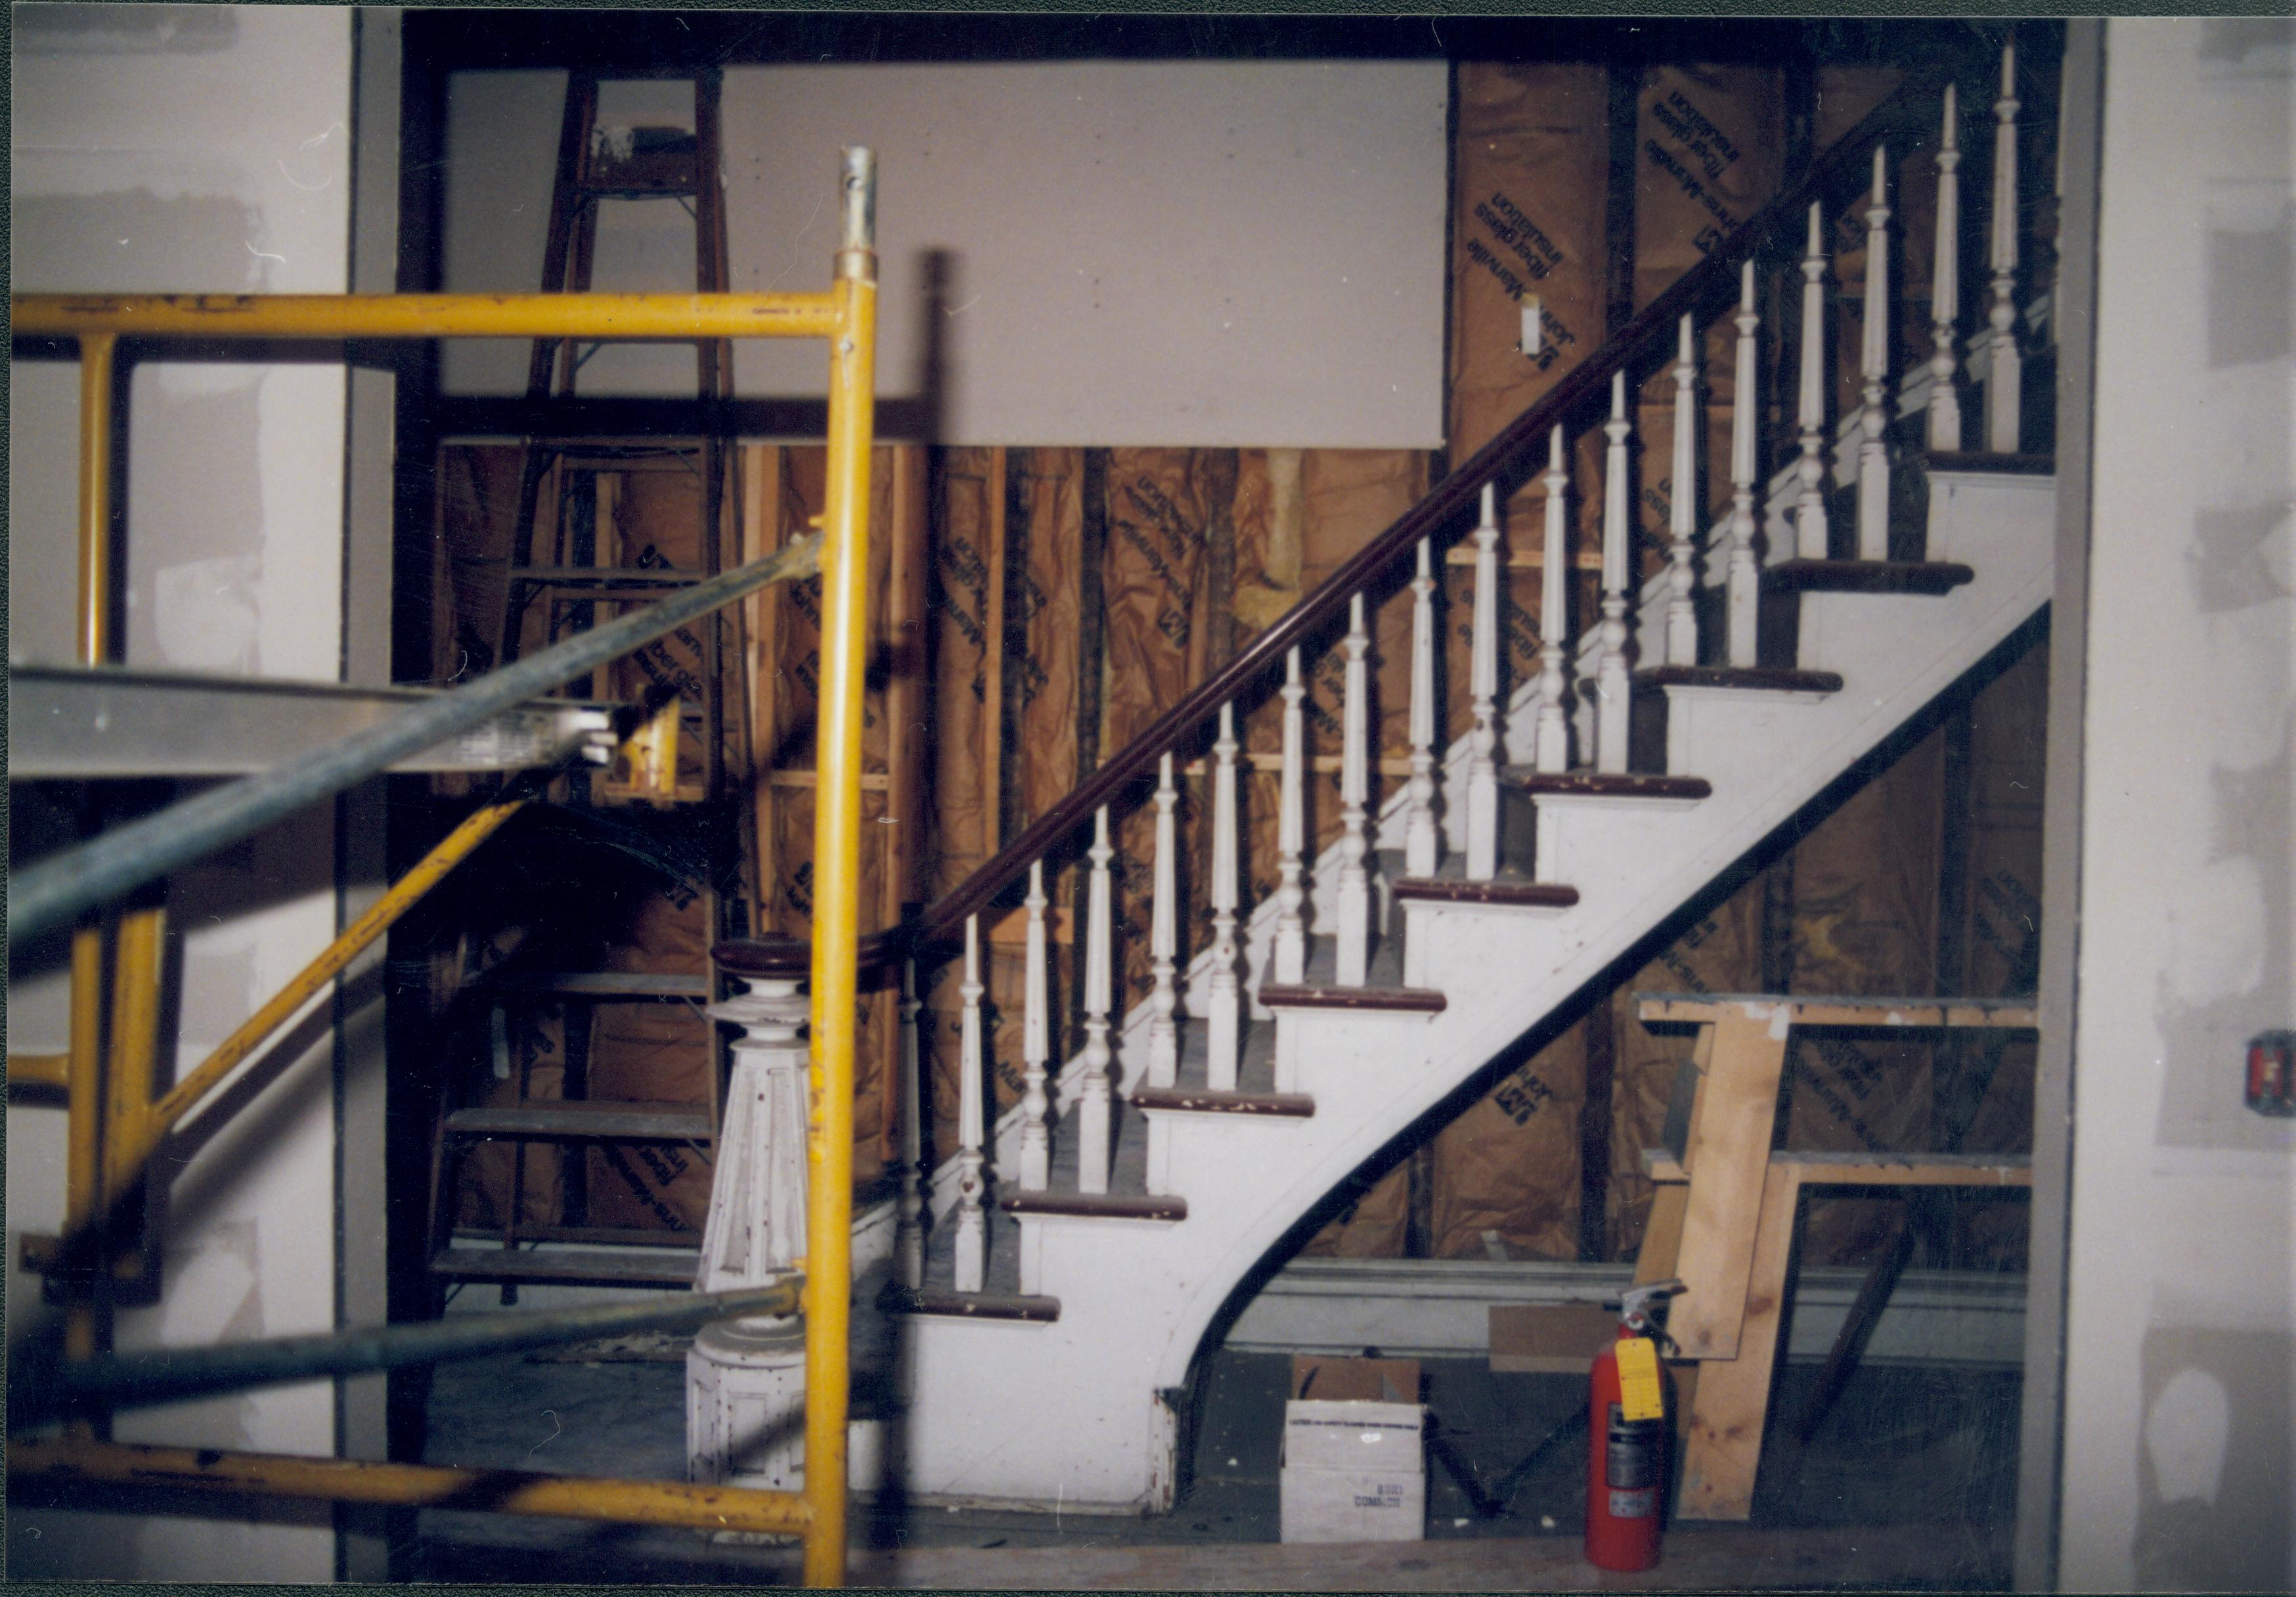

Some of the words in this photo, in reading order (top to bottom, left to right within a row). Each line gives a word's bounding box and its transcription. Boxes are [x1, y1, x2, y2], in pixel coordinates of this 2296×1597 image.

[1475, 204, 1518, 243] glass
[1492, 194, 1561, 263] insulation
[1513, 240, 1550, 280] fiber
